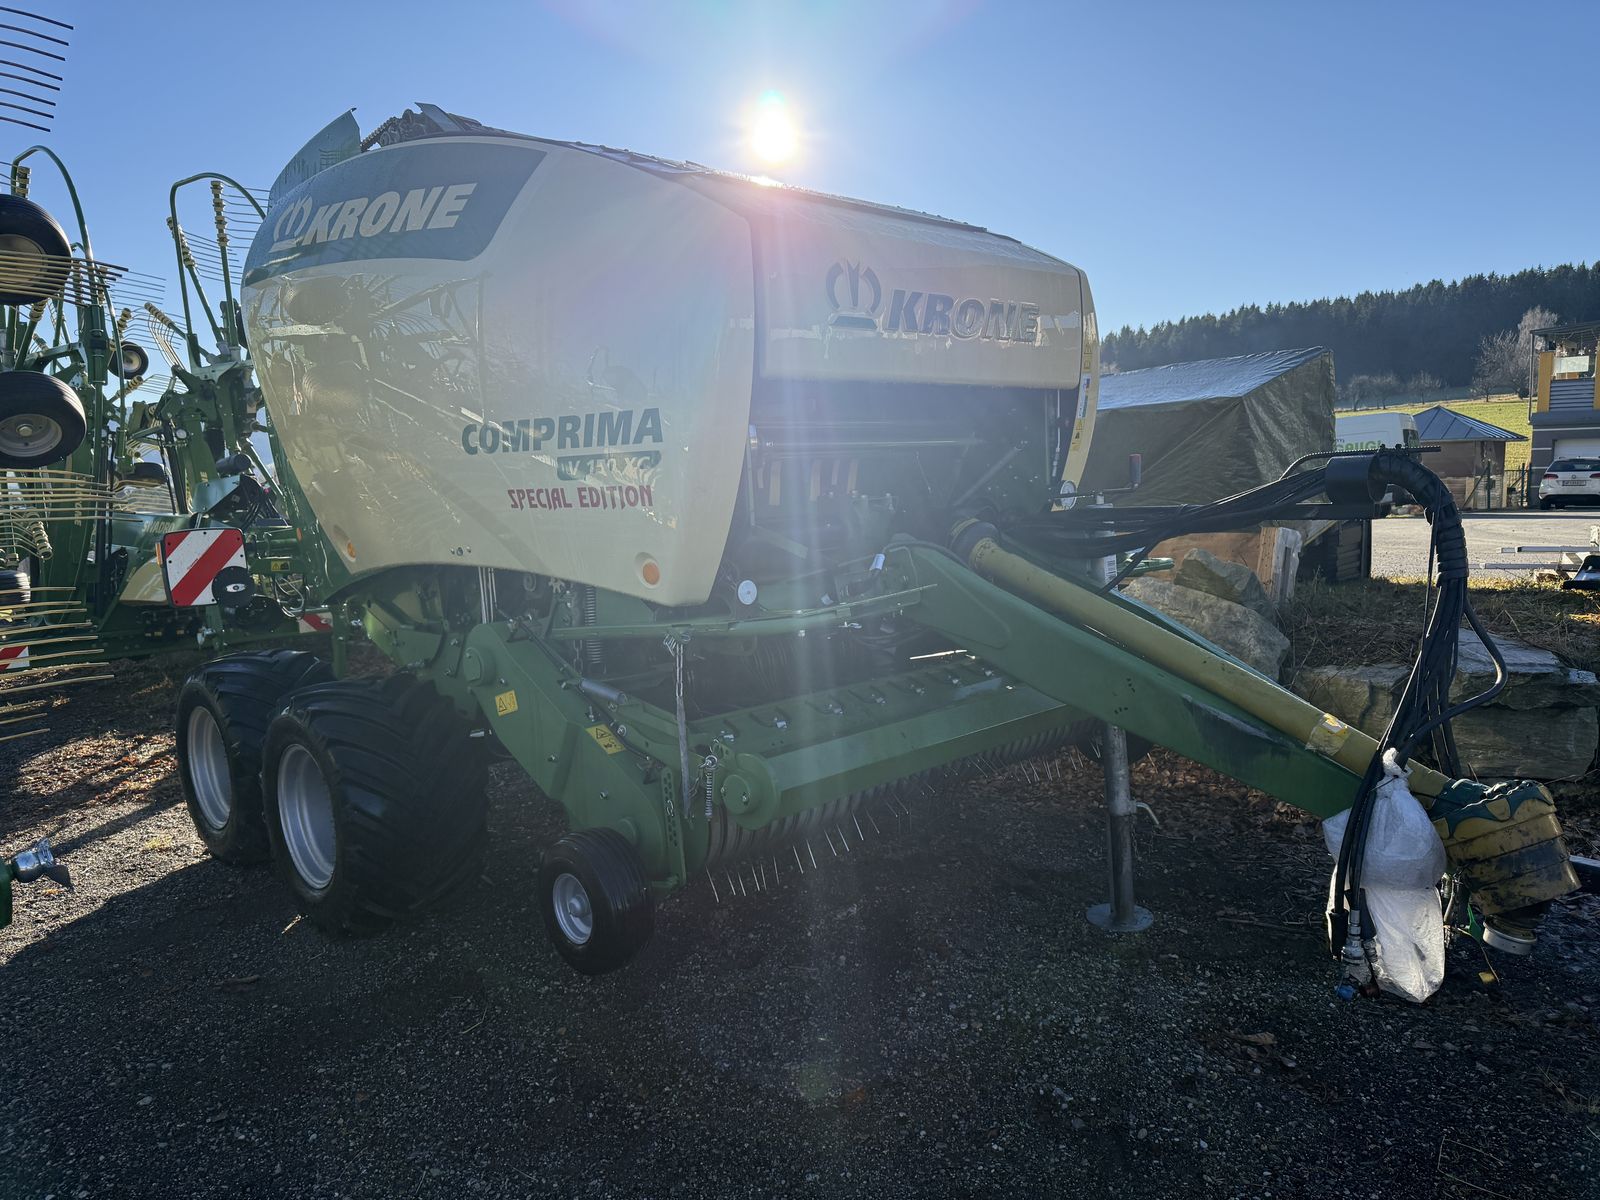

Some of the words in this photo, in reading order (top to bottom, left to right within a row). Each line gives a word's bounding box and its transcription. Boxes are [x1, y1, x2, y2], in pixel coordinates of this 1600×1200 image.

[302, 182, 479, 246] KRONE
[884, 288, 1041, 343] KRONE
[461, 408, 663, 455] COMPRIMA
[507, 488, 573, 511] SPECIAL
[577, 486, 654, 510] EDITION
